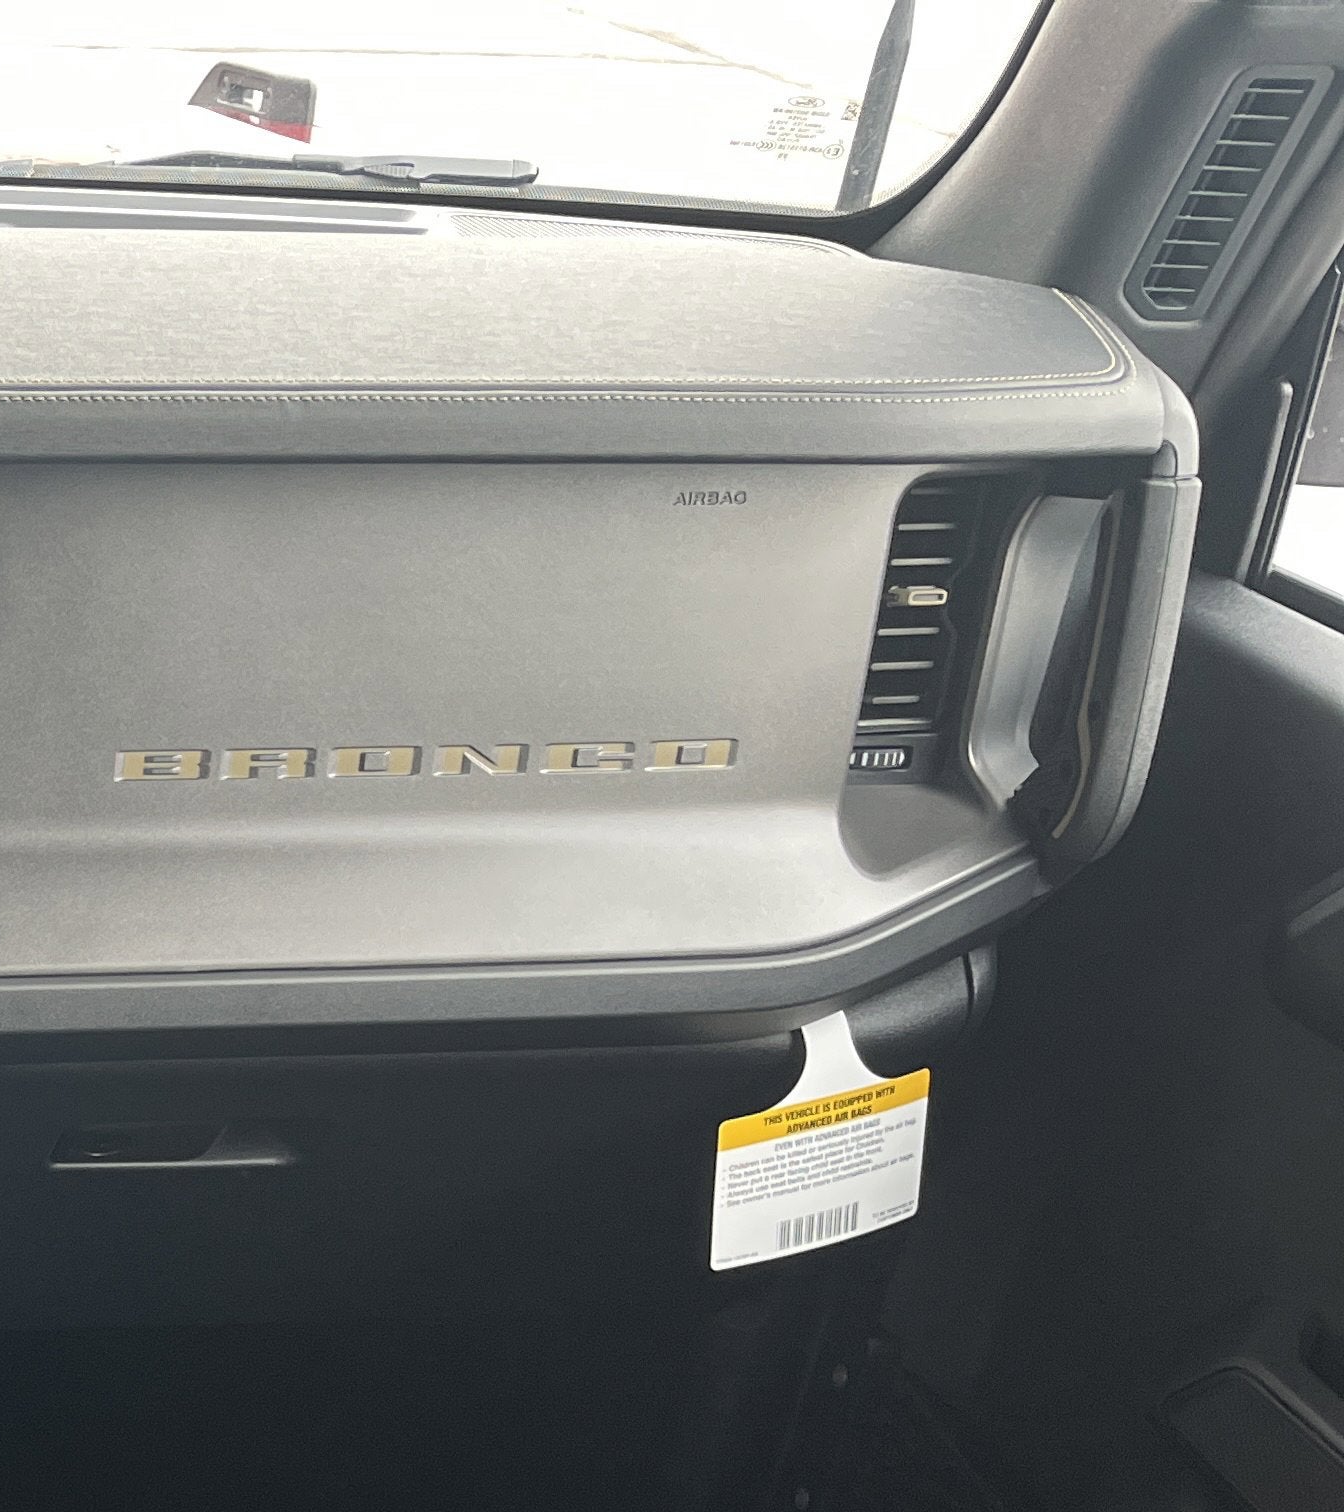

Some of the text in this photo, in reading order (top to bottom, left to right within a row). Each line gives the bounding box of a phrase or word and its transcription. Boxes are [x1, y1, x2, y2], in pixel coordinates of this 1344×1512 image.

[673, 490, 747, 506] AIRBAG
[113, 737, 739, 783] BRONCO
[764, 1086, 895, 1126] THIS VEHICLE IS EQUIPPED WITH
[787, 1105, 872, 1133] ADVANCED AIR BAGS
